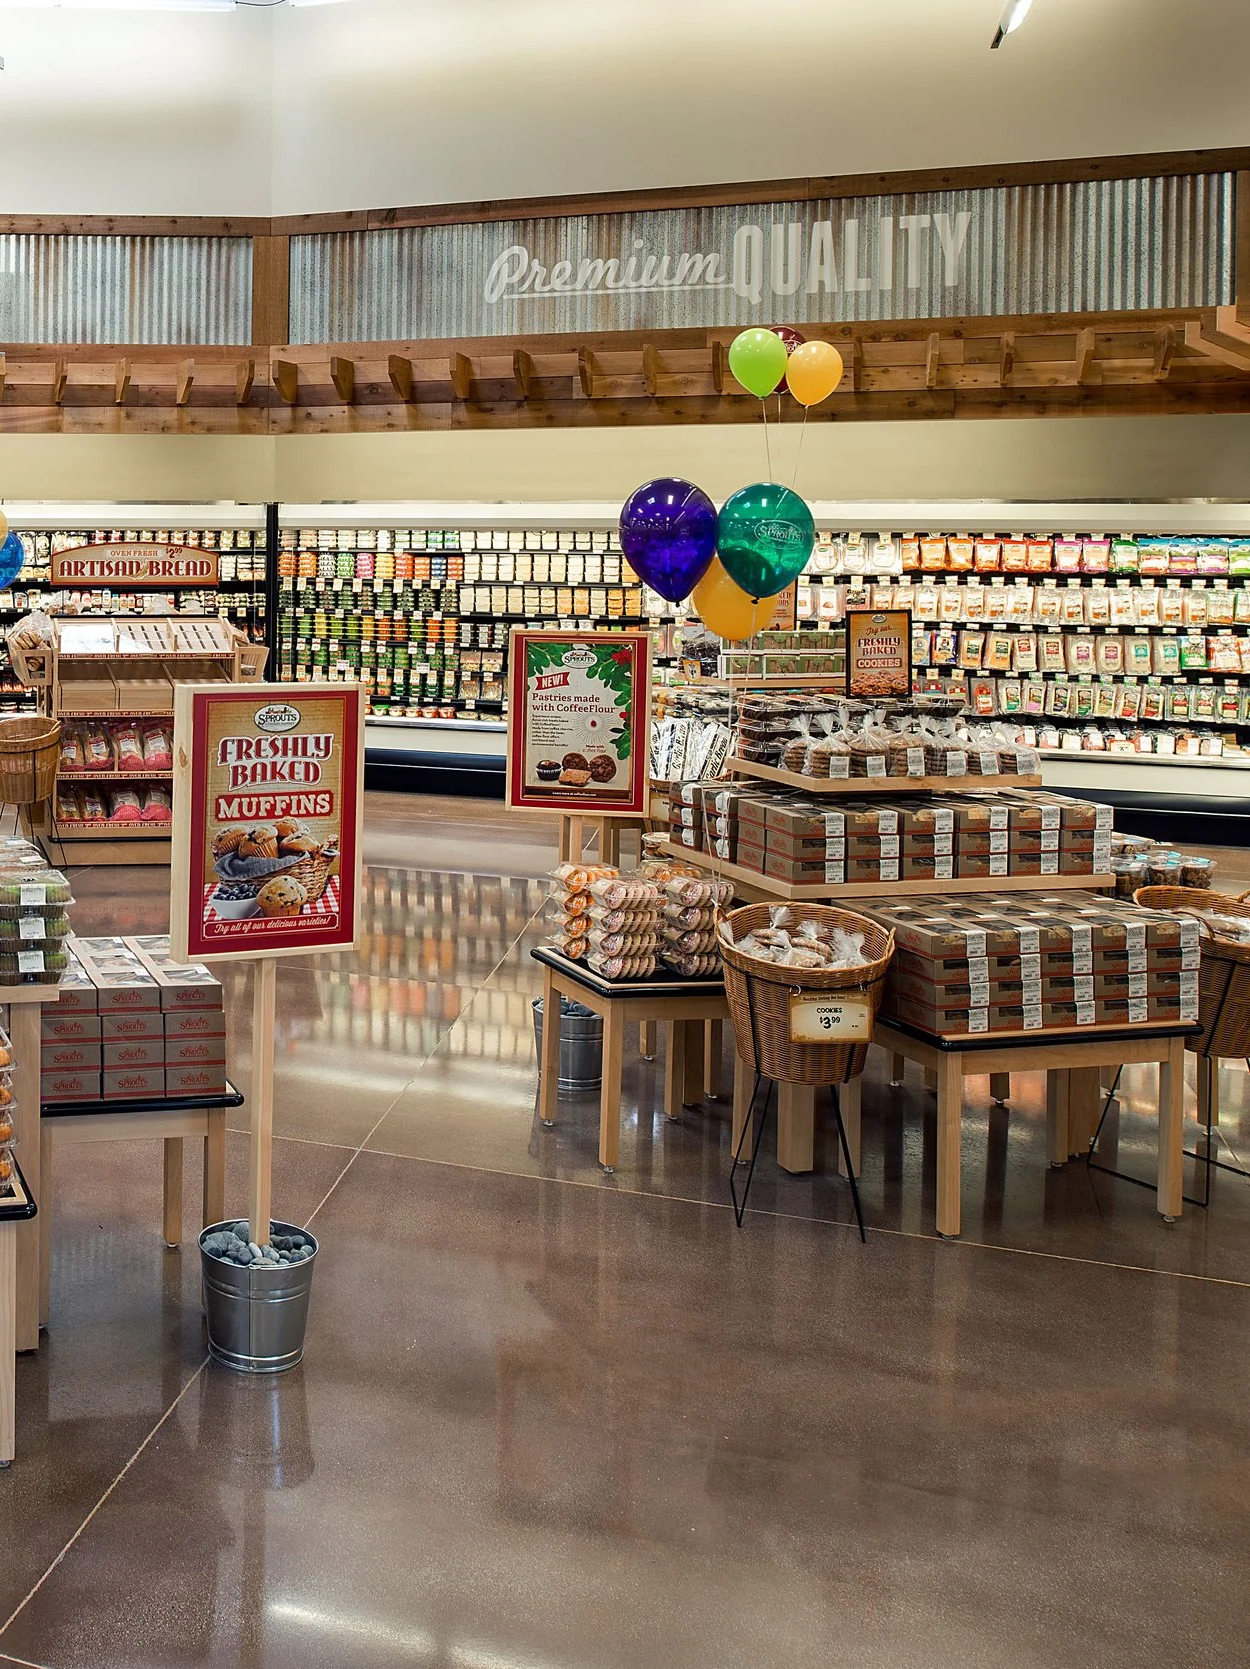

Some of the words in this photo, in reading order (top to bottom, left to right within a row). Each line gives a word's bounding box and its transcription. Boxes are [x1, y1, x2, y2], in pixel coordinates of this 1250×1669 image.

[485, 239, 728, 304] Premium
[733, 211, 973, 306] QUALITY
[760, 525, 801, 541] SPROUTS
[58, 560, 142, 577] ARTISAN
[147, 560, 212, 576] BREAD
[857, 637, 901, 648] FRESHLY
[862, 646, 897, 656] BAKED
[564, 655, 596, 664] SPROUTS
[857, 659, 901, 668] COOKIES
[541, 673, 564, 689] NEW!
[532, 692, 572, 702] Pastries
[573, 694, 600, 703] made
[532, 703, 554, 712] with
[258, 713, 297, 726] SPROUTS
[217, 733, 335, 766] FRESHLY
[228, 759, 323, 792] BAKED
[218, 794, 331, 819] MUFFINS
[214, 924, 230, 935] Try
[230, 923, 242, 931] all
[242, 922, 251, 934] of
[266, 919, 297, 929] delicious
[298, 915, 331, 927] varieties!
